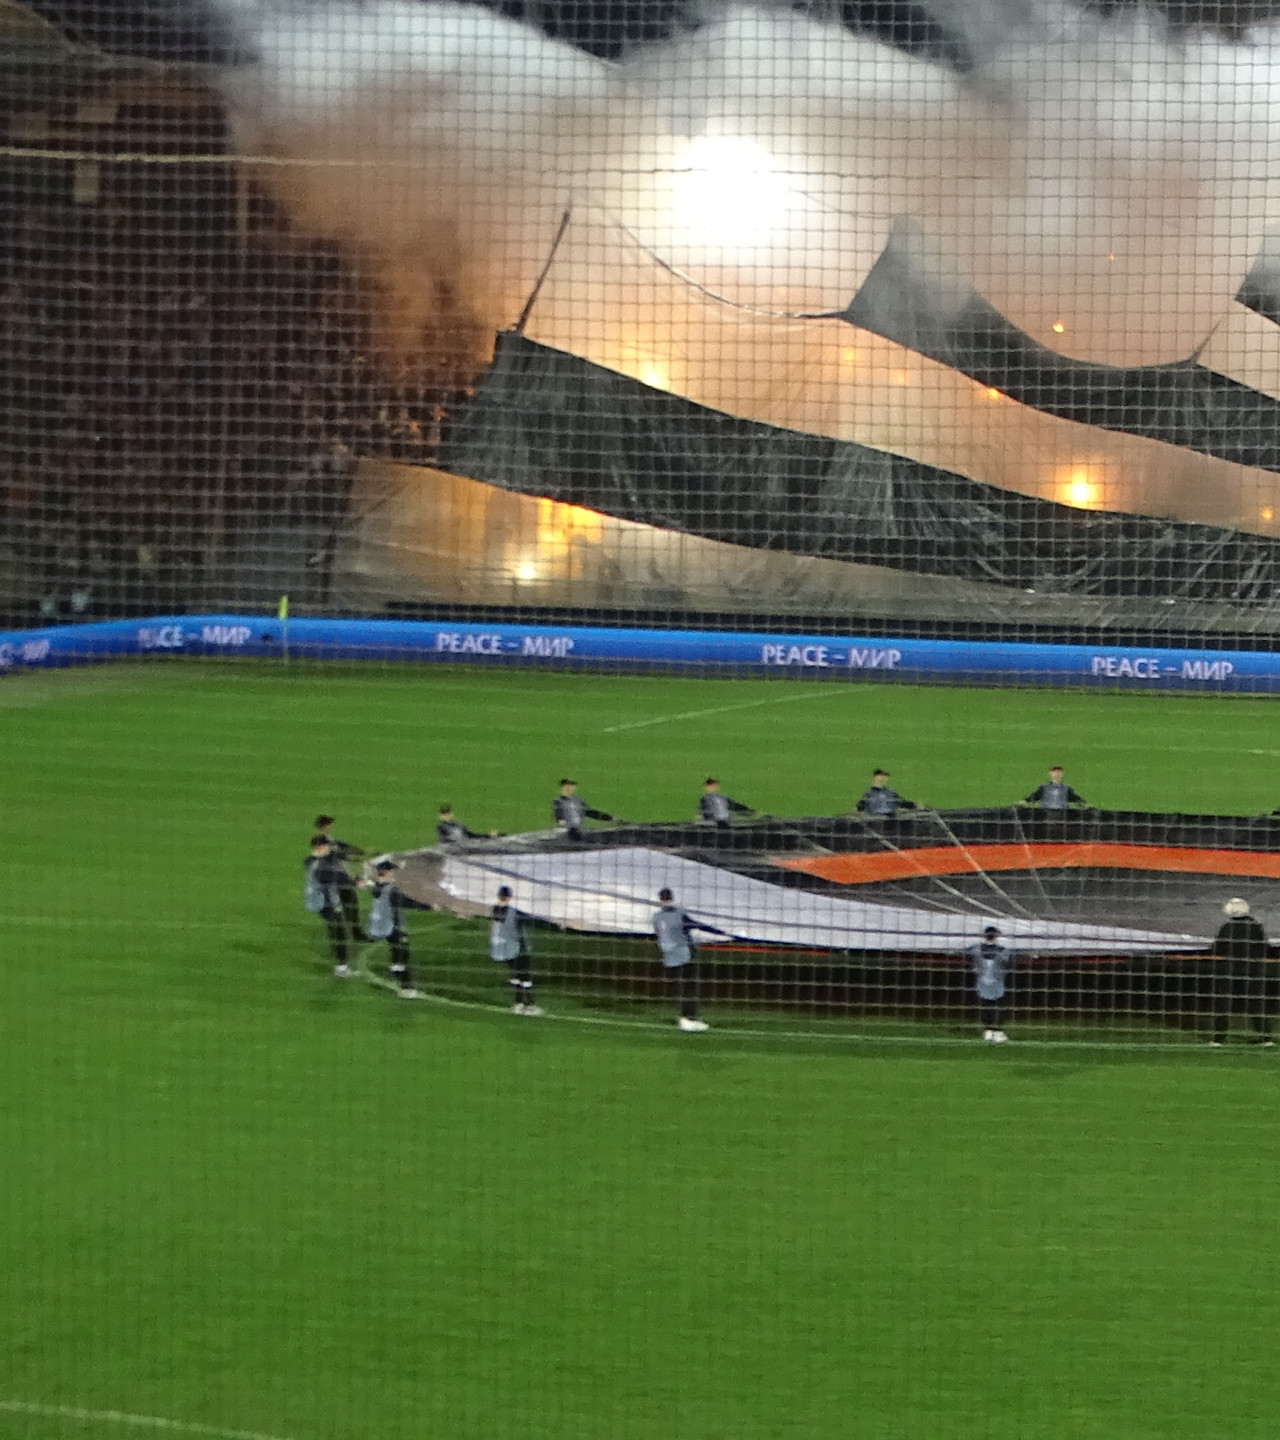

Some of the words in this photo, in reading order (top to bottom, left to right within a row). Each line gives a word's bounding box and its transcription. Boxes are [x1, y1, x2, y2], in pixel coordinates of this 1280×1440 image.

[436, 632, 503, 655] PEACE
[522, 635, 574, 657] МИР
[761, 643, 830, 667] PEACE
[849, 647, 902, 669] МИР
[1091, 656, 1160, 679] PEACE
[1181, 659, 1234, 681] МИР
